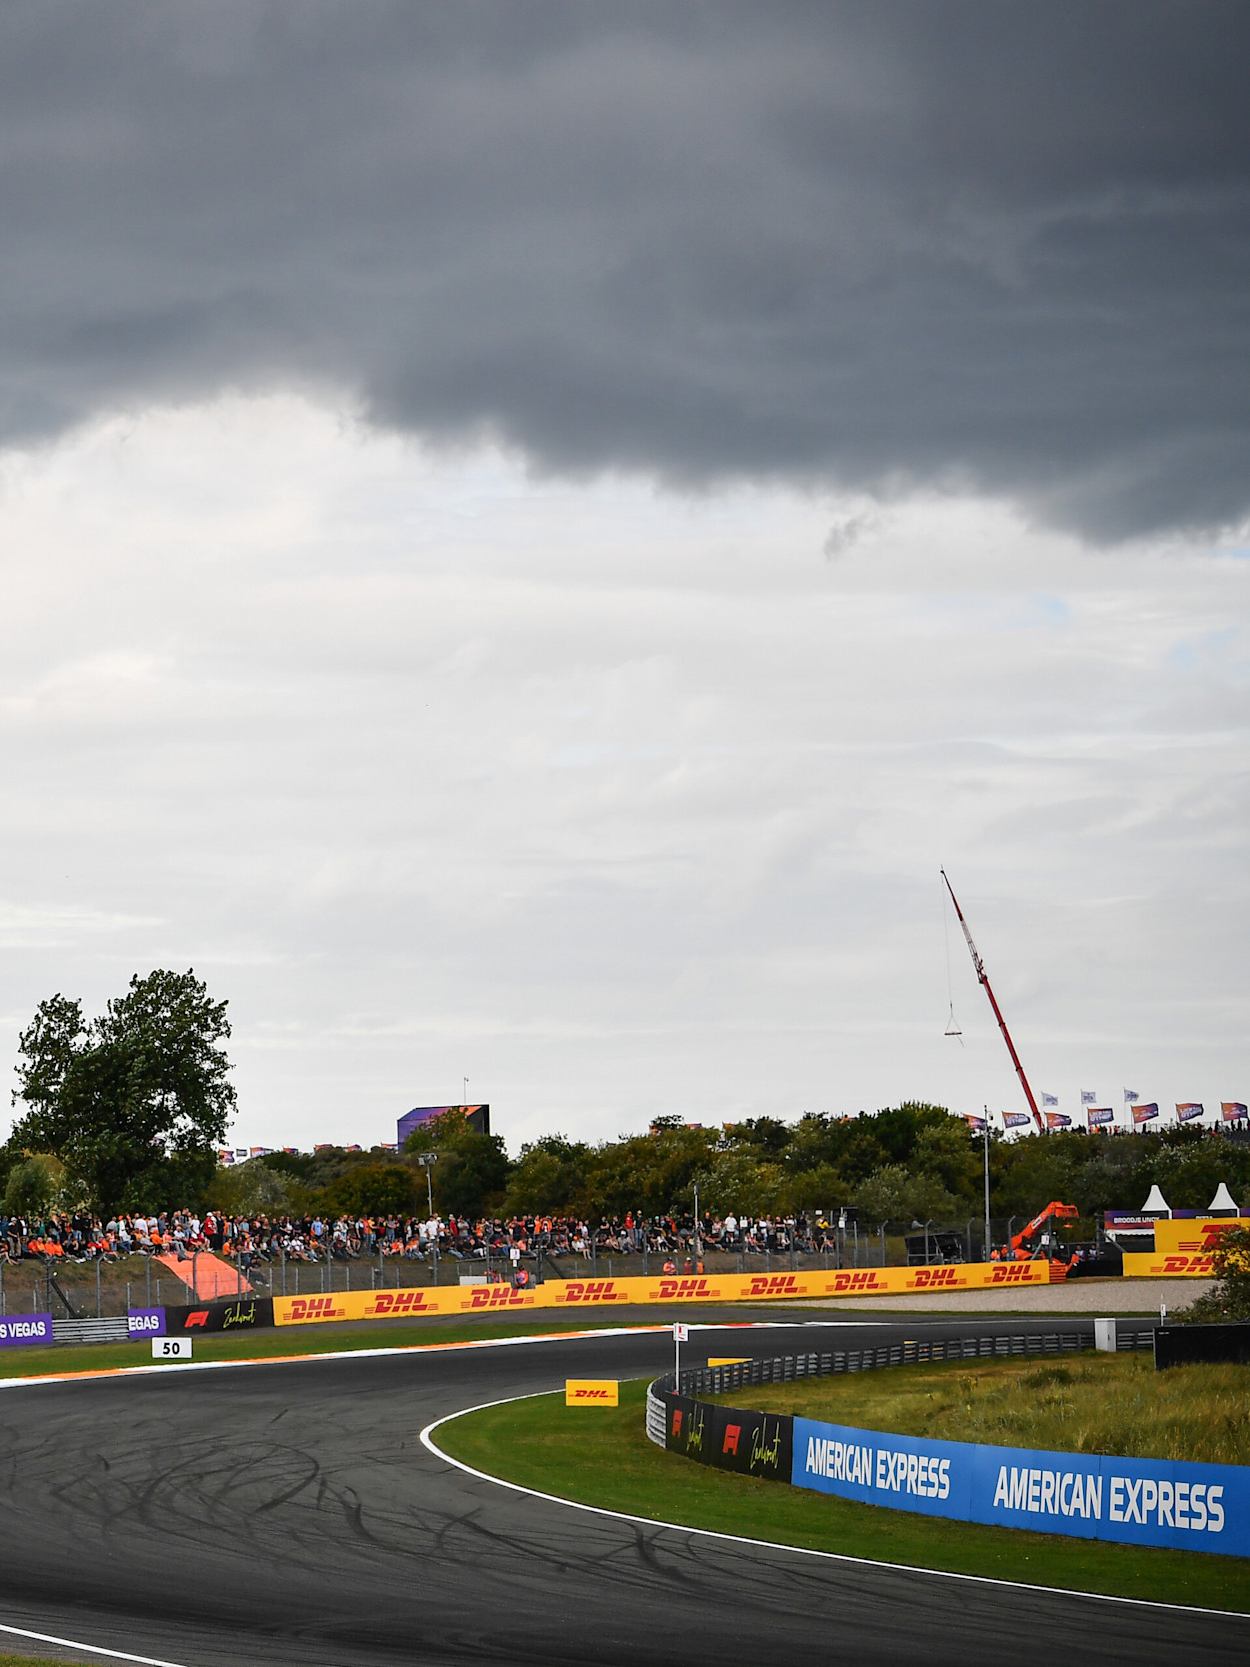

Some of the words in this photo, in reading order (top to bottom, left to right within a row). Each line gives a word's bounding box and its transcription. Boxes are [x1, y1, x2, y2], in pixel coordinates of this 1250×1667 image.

[992, 1265, 1034, 1282] DHL
[1162, 1256, 1214, 1273] DH
[751, 1277, 798, 1294] DHL
[835, 1273, 879, 1290] DHL
[915, 1269, 959, 1287] DHL
[472, 1288, 523, 1307] DHL
[566, 1283, 617, 1301] DHL
[660, 1280, 710, 1298] DHL
[292, 1299, 336, 1319] DHL
[375, 1293, 427, 1313] DHL
[8, 1322, 45, 1337] VEGAS
[128, 1316, 159, 1331] EGAS
[163, 1343, 179, 1354] 50
[806, 1437, 872, 1486] AMERICAN
[876, 1450, 950, 1499] EXPRESS
[994, 1466, 1102, 1519] AMERICAN
[1110, 1477, 1224, 1531] EXPRESS
